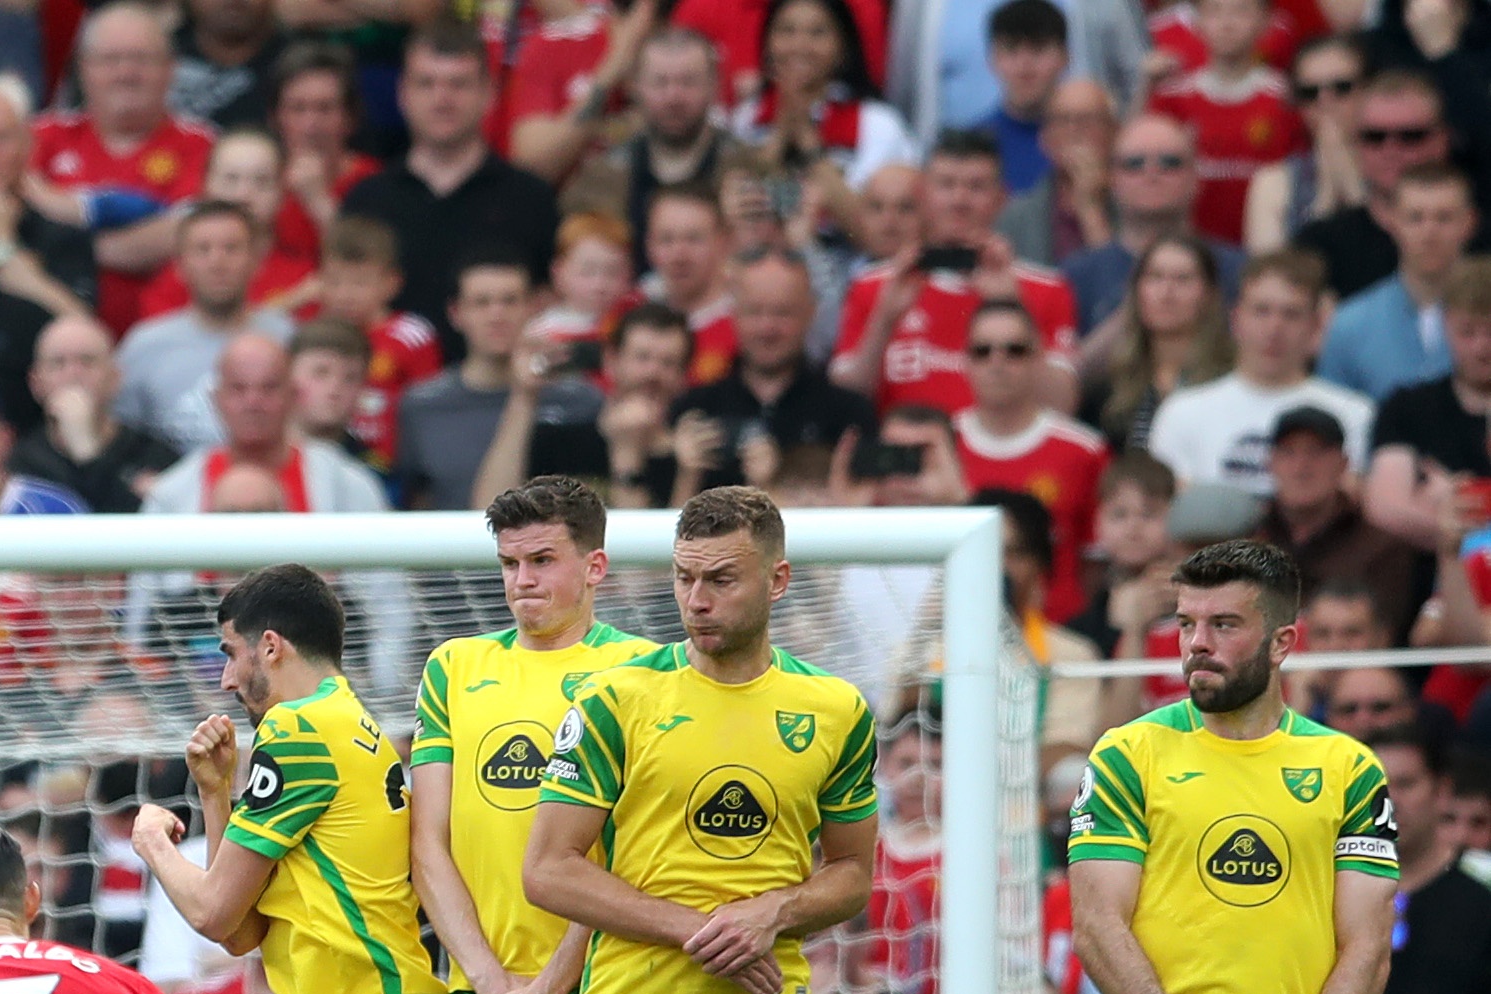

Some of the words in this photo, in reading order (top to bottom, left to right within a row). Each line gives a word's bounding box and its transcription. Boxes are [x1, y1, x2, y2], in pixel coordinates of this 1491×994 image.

[486, 766, 547, 780] LOTUS
[699, 812, 764, 829] LOTUS
[1212, 859, 1279, 878] LOTUS
